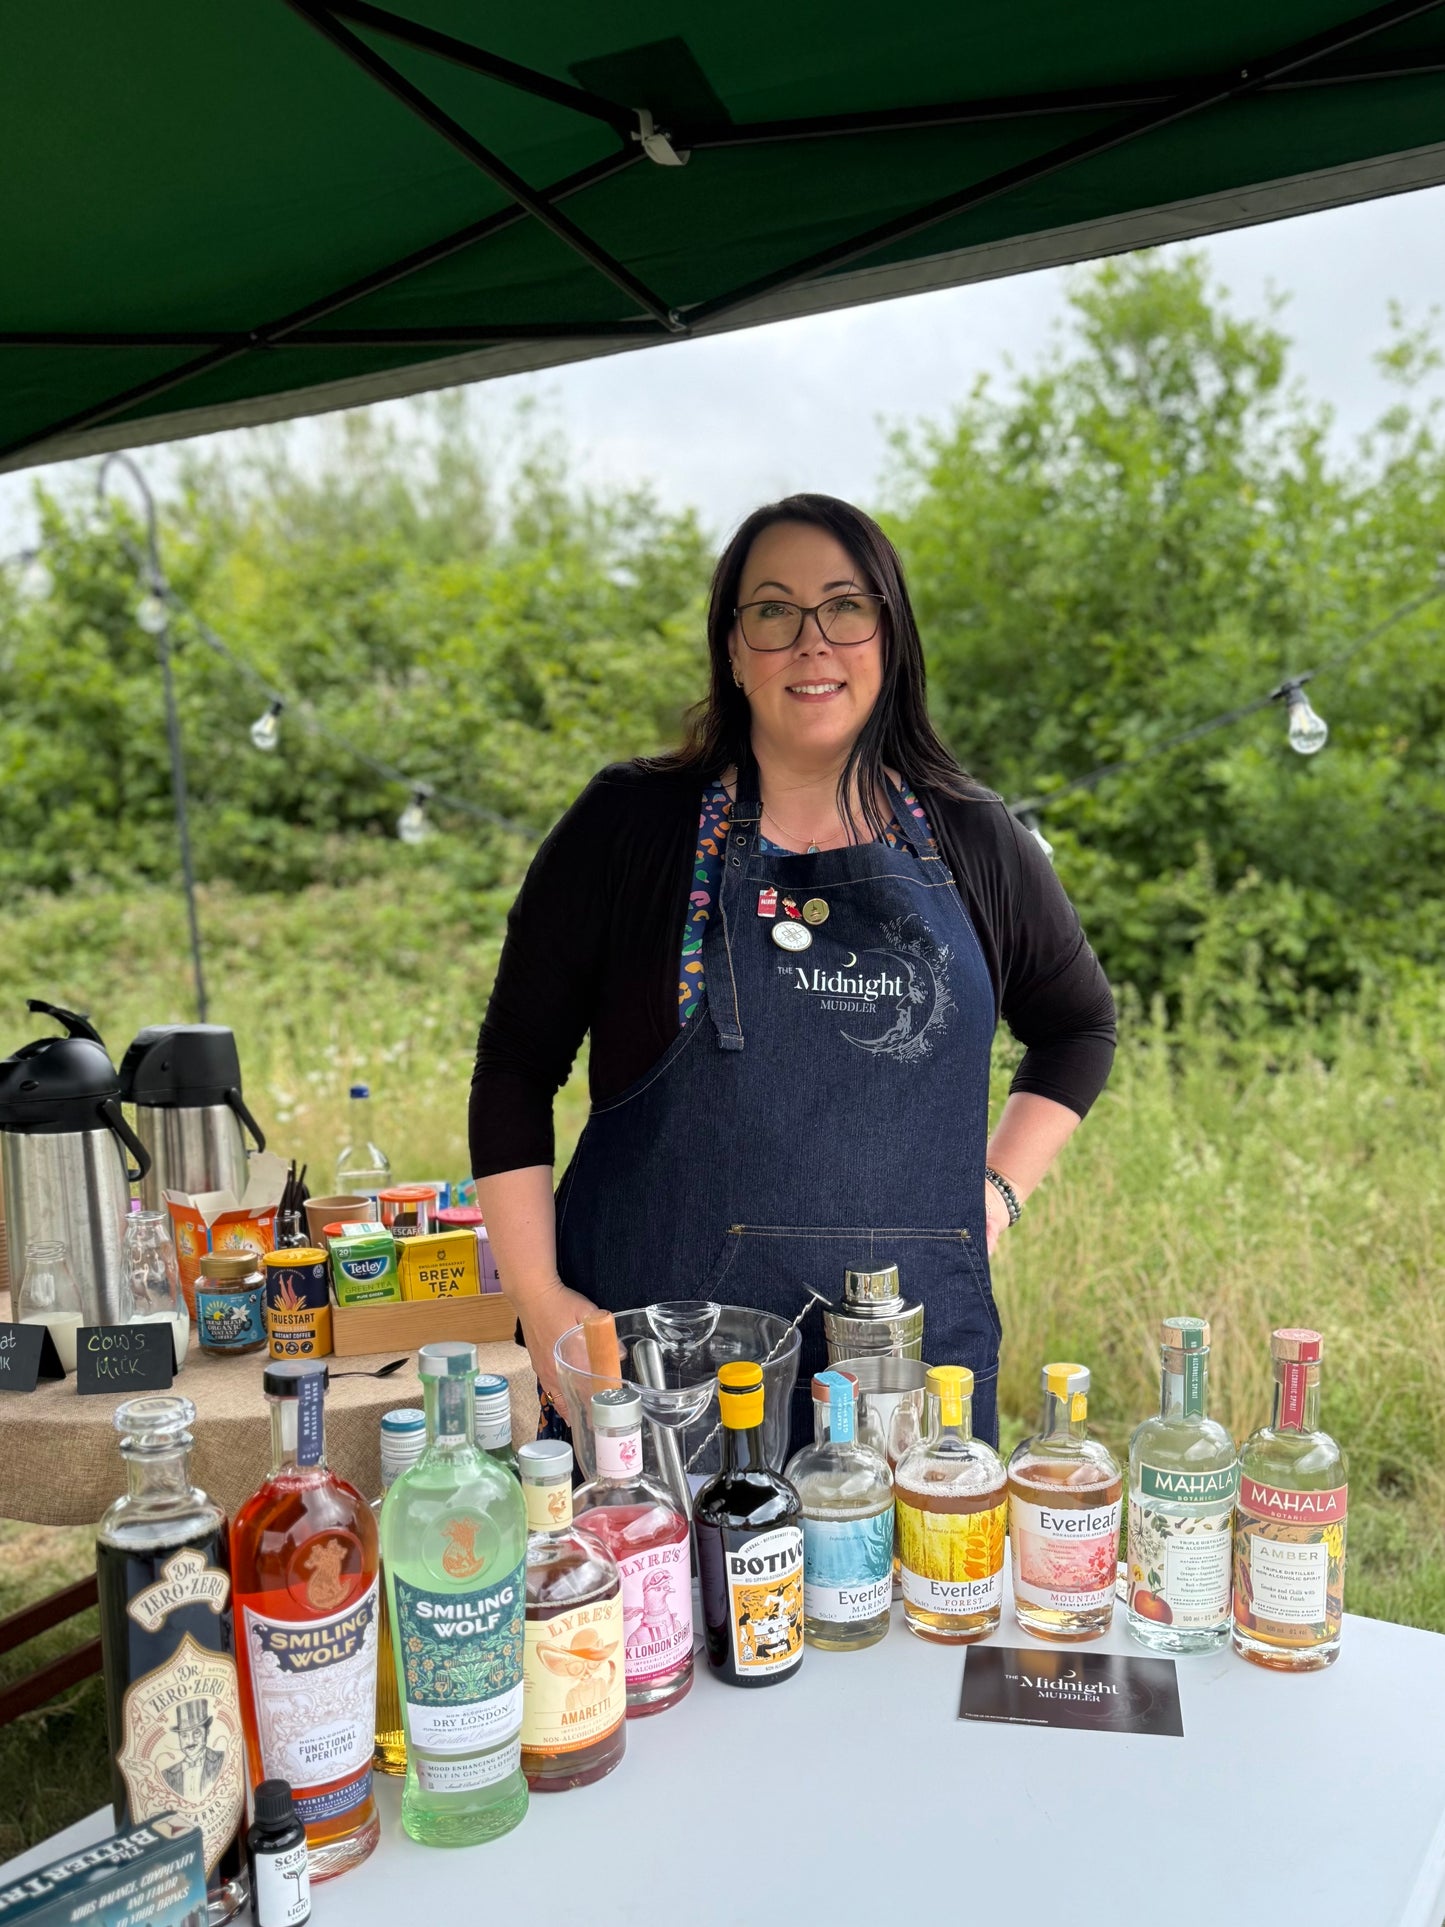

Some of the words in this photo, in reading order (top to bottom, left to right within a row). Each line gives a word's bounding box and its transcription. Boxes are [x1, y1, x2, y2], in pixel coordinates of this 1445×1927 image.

[777, 966, 793, 975] THE
[793, 967, 904, 1001] Midnight
[820, 1000, 877, 1014] MUDDLER
[347, 1260, 382, 1275] Tetley
[420, 1267, 465, 1281] BREW
[345, 1284, 374, 1294] GREEN
[375, 1281, 392, 1290] TEA
[429, 1280, 459, 1292] TEA
[271, 1313, 315, 1324] TRUESTART
[0, 1330, 17, 1349] at
[1155, 1471, 1233, 1493] MAHALA
[1252, 1484, 1336, 1512] MAHALA
[1040, 1506, 1117, 1532] Everleaf
[1271, 1511, 1313, 1521] BOTANIC
[621, 1548, 681, 1577] LYRE'S
[731, 1538, 802, 1575] BOTIVO
[1260, 1546, 1318, 1560] AMBER
[141, 1584, 183, 1616] ZERO
[190, 1577, 224, 1596] ZERO
[930, 1576, 994, 1597] Everleaf
[1050, 1591, 1106, 1602] MOUNTAIN
[416, 1586, 514, 1619] SMILING
[852, 1597, 886, 1613] MARINE
[945, 1597, 983, 1606] FOREST
[270, 1609, 368, 1650] SMILING
[433, 1613, 501, 1637] WOLF
[547, 1604, 613, 1637] LYRE'S
[289, 1636, 356, 1668] WOLF
[635, 1638, 671, 1658] LONDON
[149, 1684, 187, 1712] ZERO
[194, 1678, 225, 1695] ZERO
[1019, 1675, 1120, 1696] Midnight
[1038, 1690, 1101, 1703] MUDDLER
[433, 1719, 457, 1727] DRY
[461, 1705, 508, 1725] LONDON
[561, 1697, 611, 1725] AMARETTI
[299, 1731, 356, 1755] FUNCTIONAL
[305, 1742, 353, 1763] APERITIVO
[452, 1757, 496, 1771] ENHANCING
[463, 1767, 485, 1777] GIN'S
[298, 1796, 325, 1806] SPIRIT
[127, 1893, 145, 1910] AND
[287, 1899, 309, 1917] LIGHT
